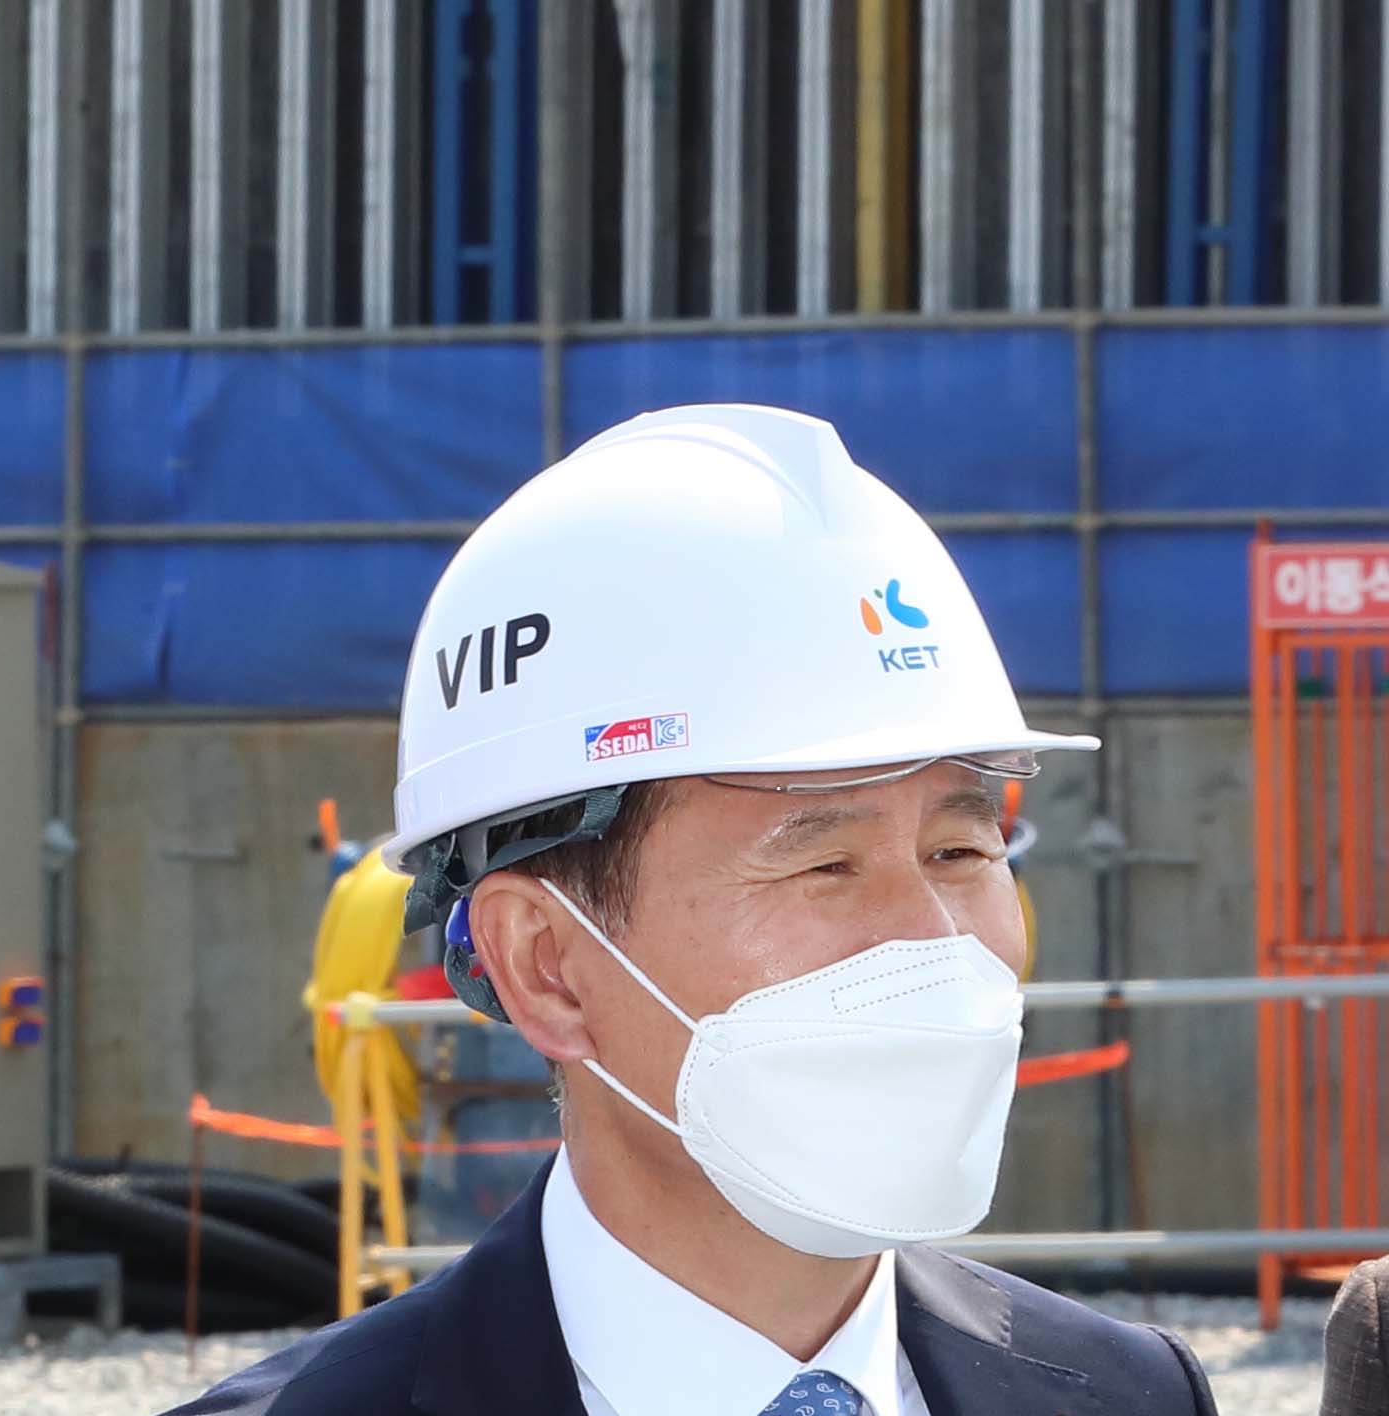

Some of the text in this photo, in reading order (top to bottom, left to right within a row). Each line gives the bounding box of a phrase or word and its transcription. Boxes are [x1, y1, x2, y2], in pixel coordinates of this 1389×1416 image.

[436, 612, 551, 711] VIP
[878, 645, 939, 673] KET
[588, 733, 650, 761] SSEDA
